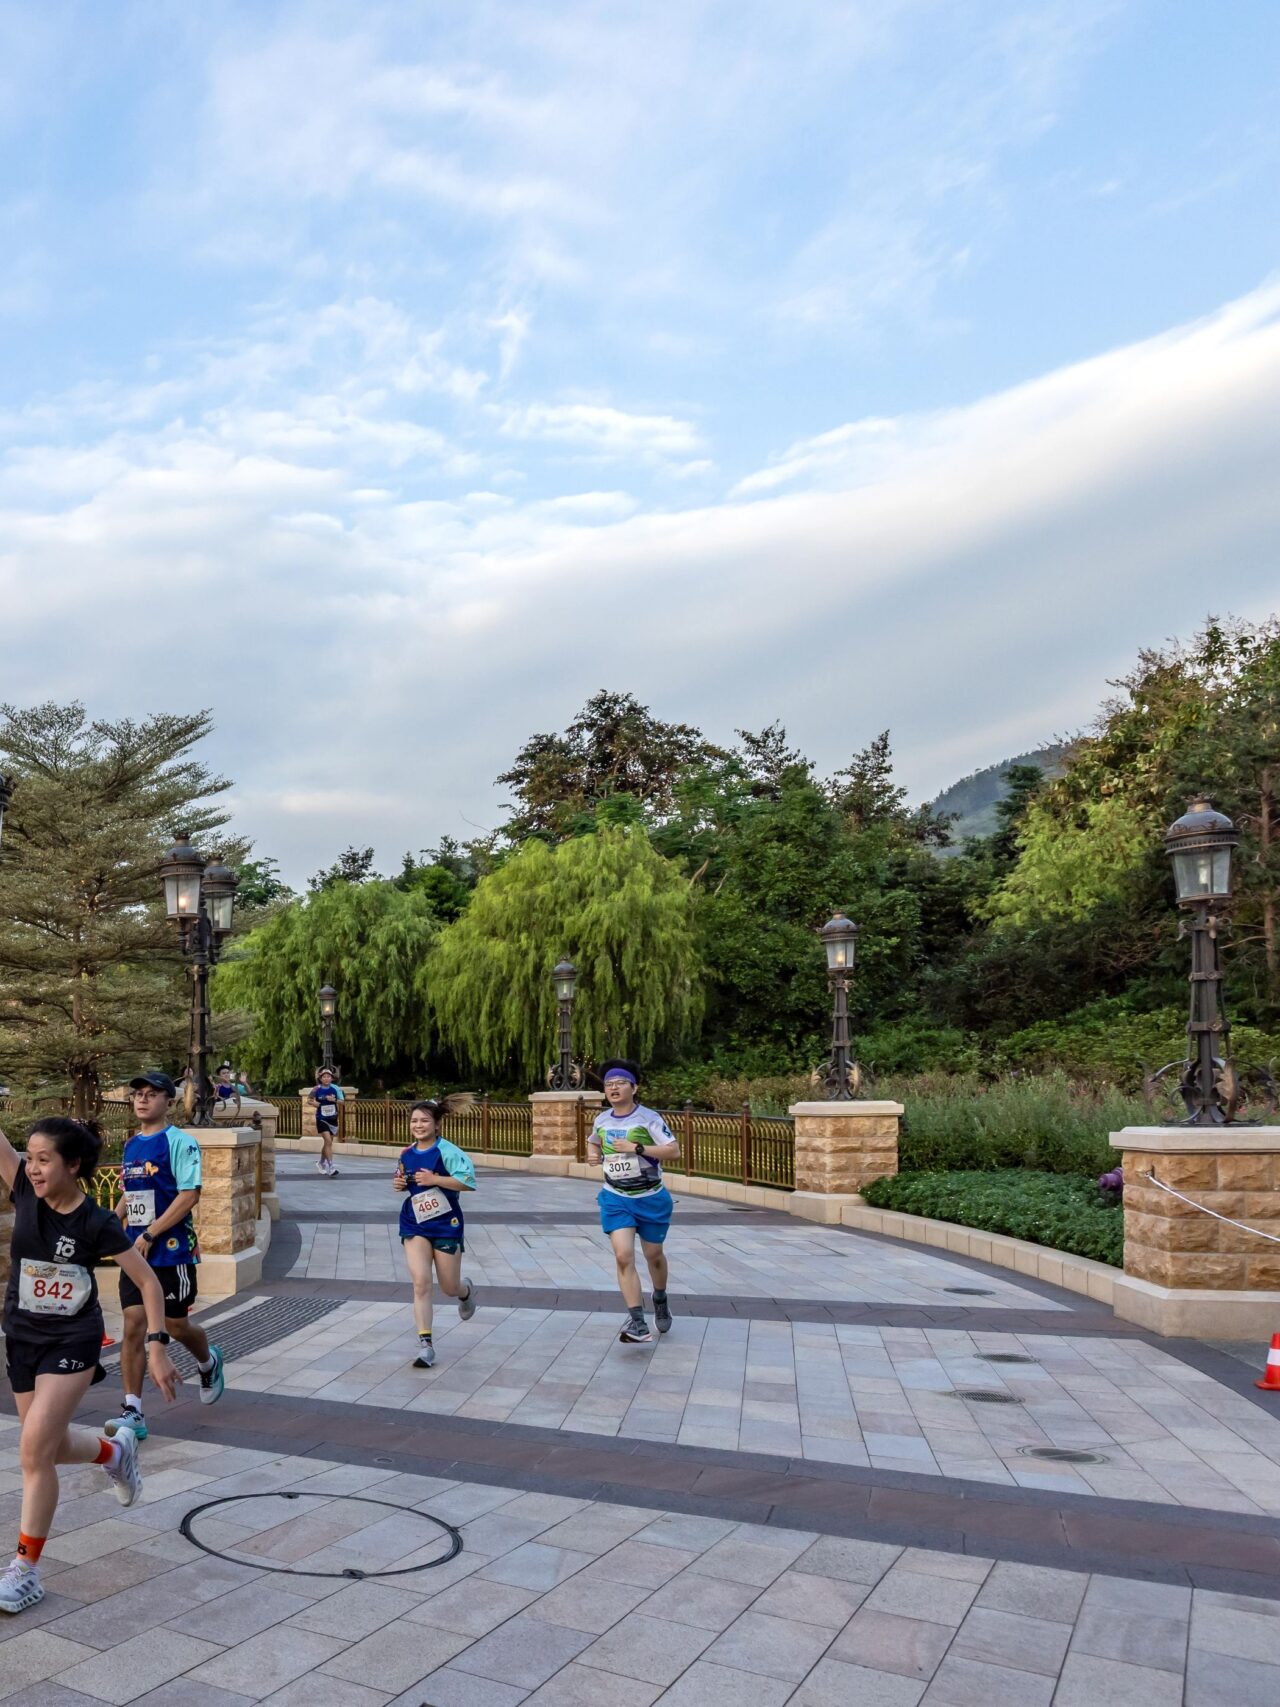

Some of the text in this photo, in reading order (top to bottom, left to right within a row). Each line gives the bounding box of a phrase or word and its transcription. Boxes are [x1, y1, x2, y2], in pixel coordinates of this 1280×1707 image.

[609, 1162, 632, 1173] 3012
[418, 1198, 440, 1213] 466
[34, 1280, 73, 1300] 842
